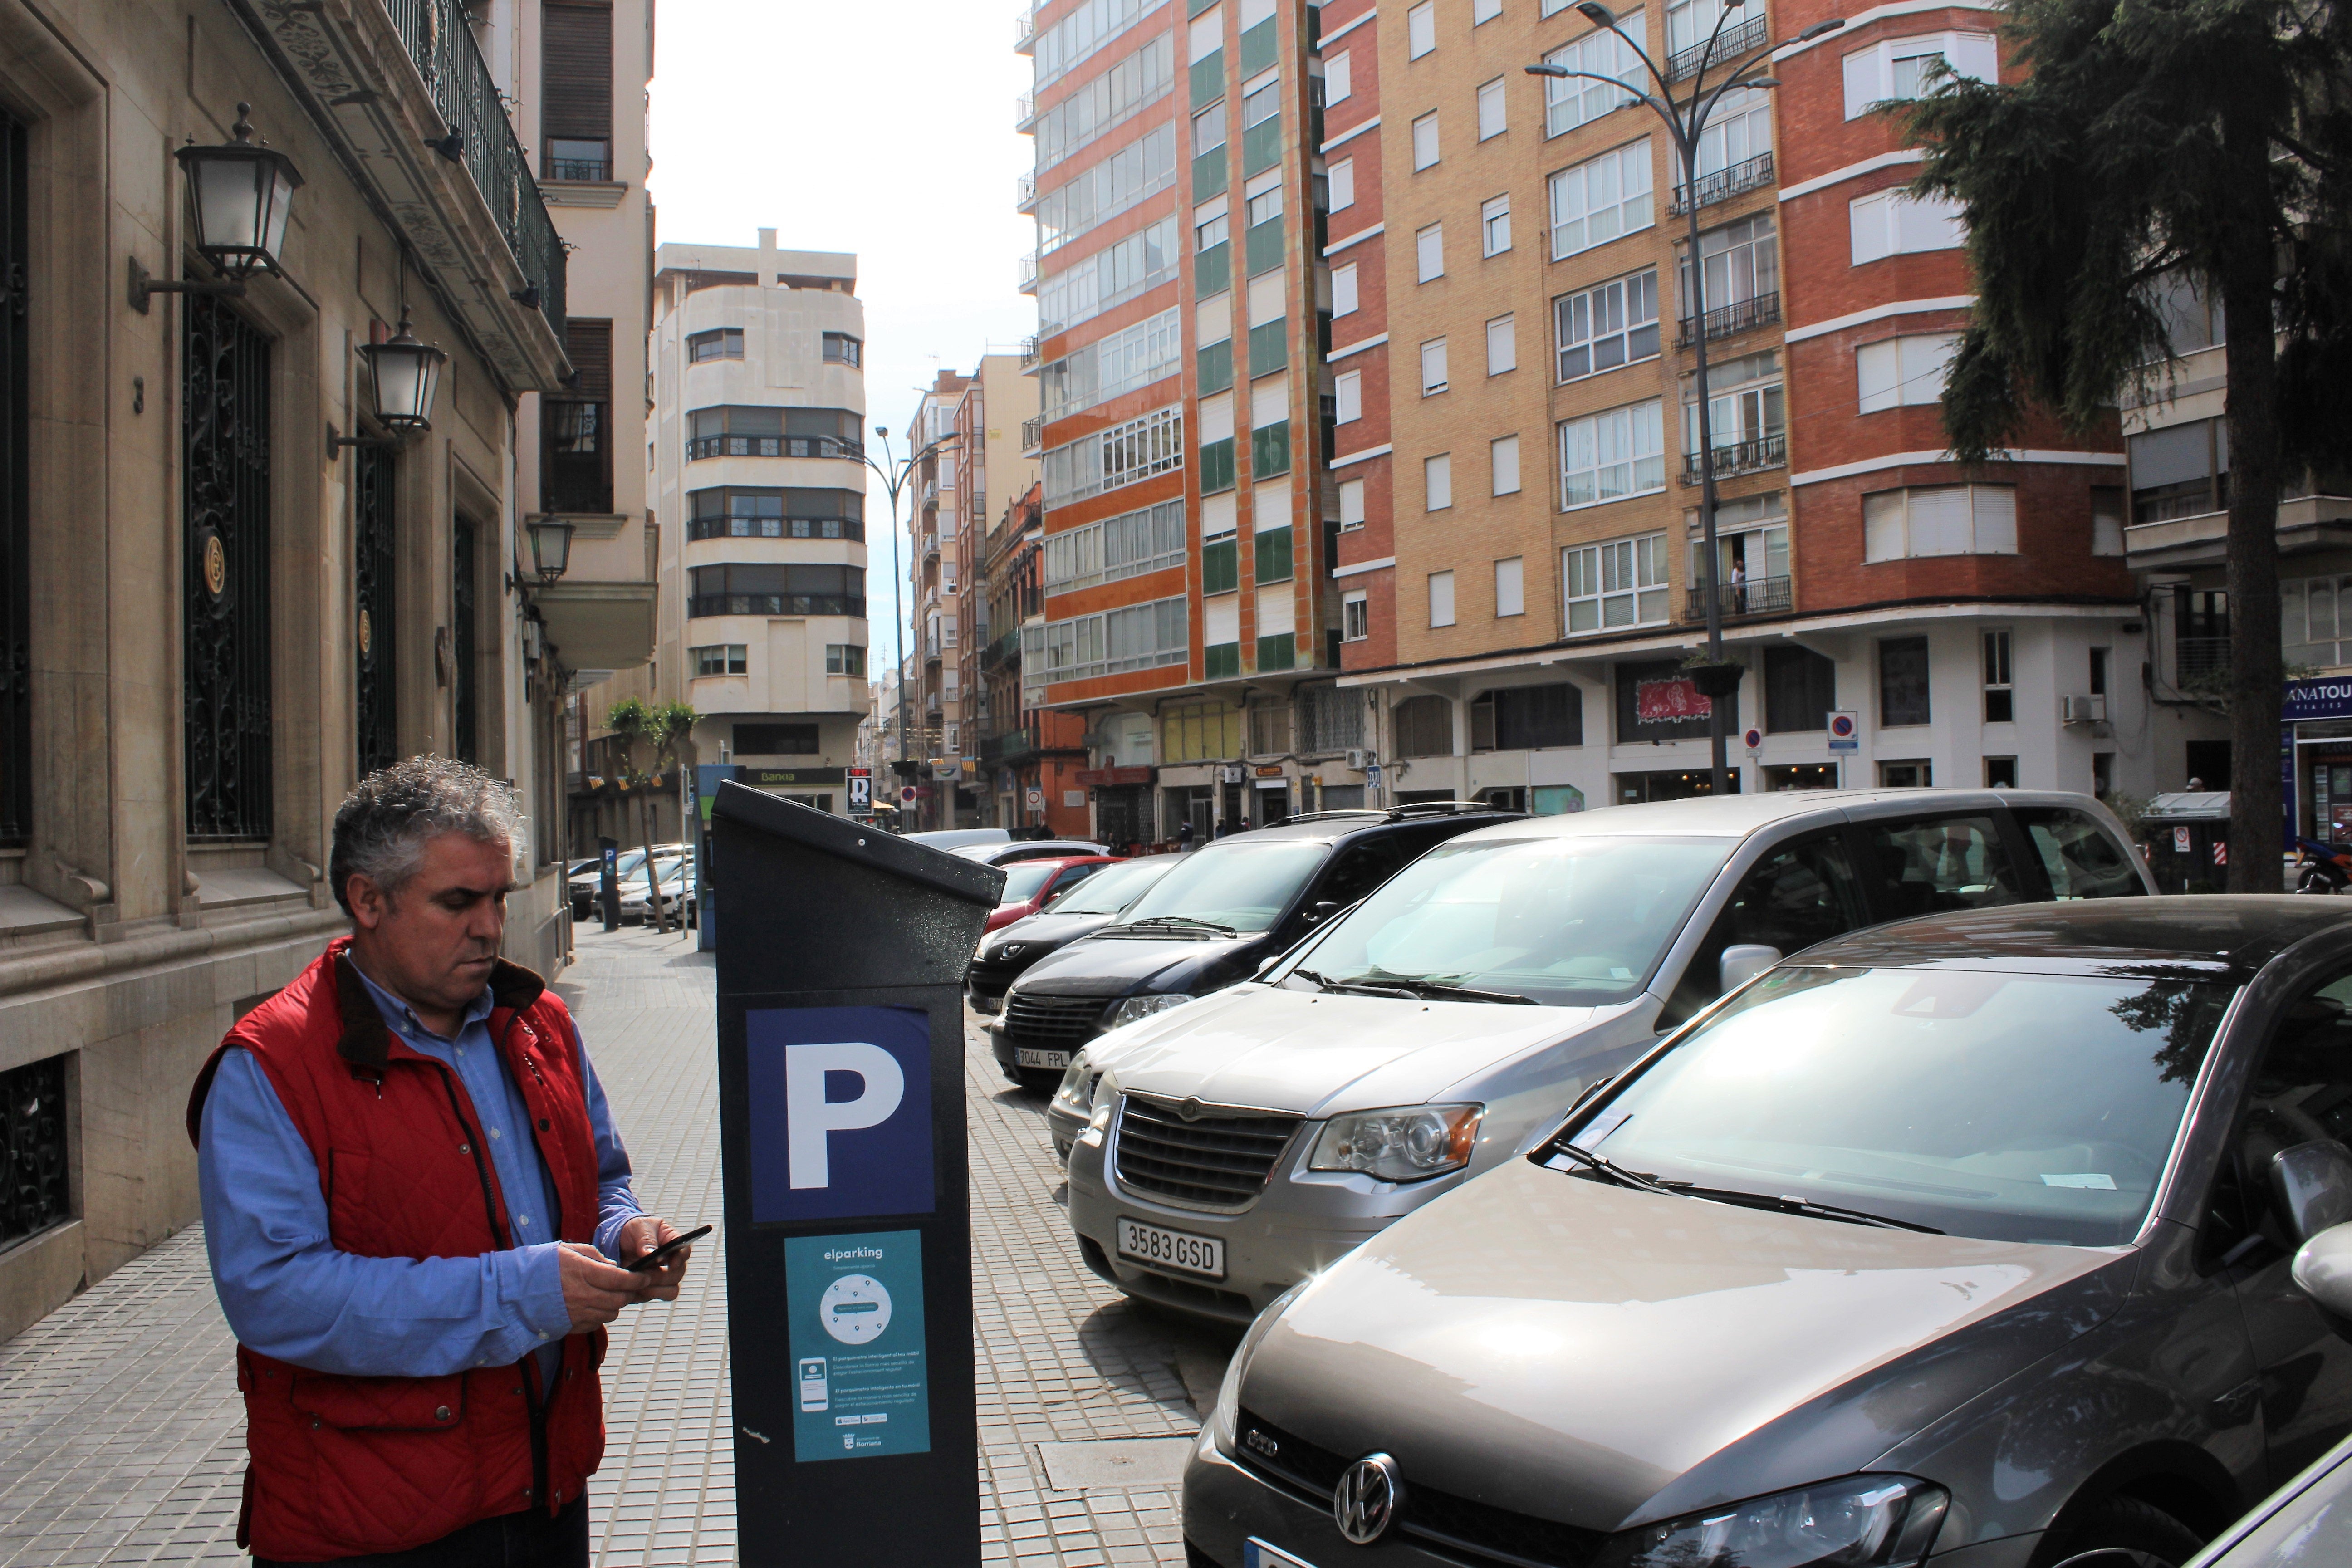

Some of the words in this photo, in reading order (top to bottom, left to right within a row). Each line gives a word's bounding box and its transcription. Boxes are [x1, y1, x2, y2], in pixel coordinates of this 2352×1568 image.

[762, 773, 794, 781] Bankia
[1369, 771, 1380, 782] TAXI
[850, 779, 868, 802] R
[605, 850, 613, 860] P
[1019, 1050, 1041, 1065] 7044
[1048, 1053, 1068, 1067] FPL
[785, 1042, 904, 1189] P
[824, 1247, 883, 1262] elparking
[1129, 1225, 1172, 1260] 3583
[1176, 1237, 1214, 1269] GSD
